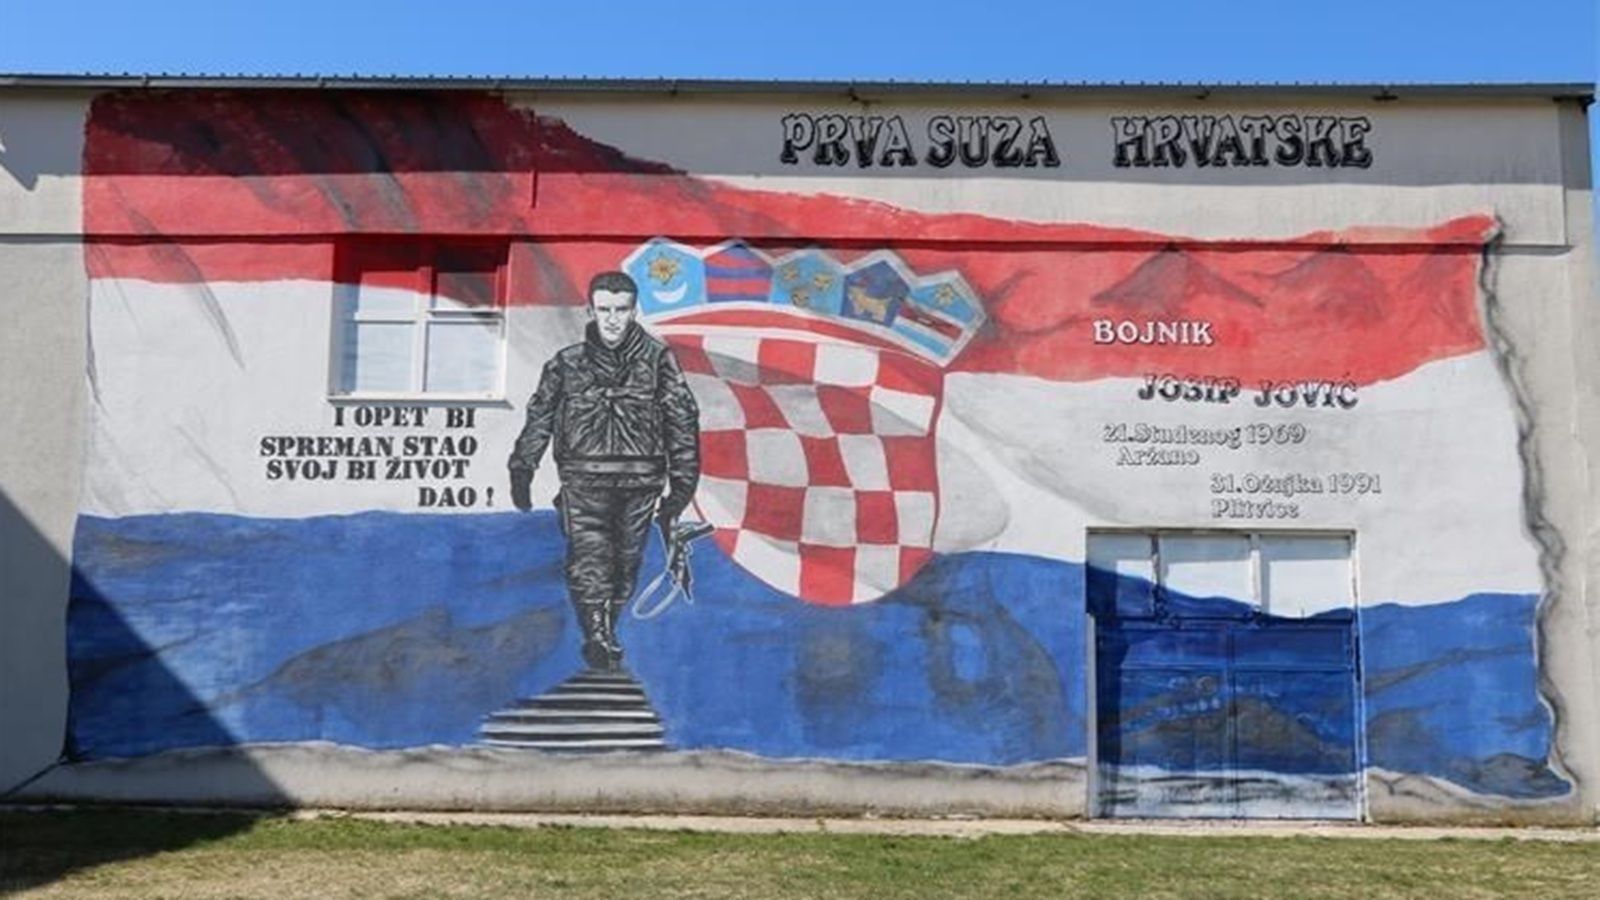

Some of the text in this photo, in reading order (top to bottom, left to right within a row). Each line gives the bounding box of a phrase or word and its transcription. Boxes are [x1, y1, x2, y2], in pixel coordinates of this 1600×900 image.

[781, 114, 1373, 169] PRVA SUZA HRVATSKE
[1093, 320, 1213, 346] BOJNIK
[1137, 372, 1358, 409] JOSIP JOVIĆ
[334, 407, 476, 428] I OPET BI
[1248, 423, 1306, 445] 1969
[260, 436, 478, 457] SPREMAN STAO
[266, 456, 470, 480] SVOJ BI ŽIVOT
[1329, 473, 1382, 494] 1991
[418, 487, 477, 507] DAO
[1212, 498, 1299, 518] Plitvice
